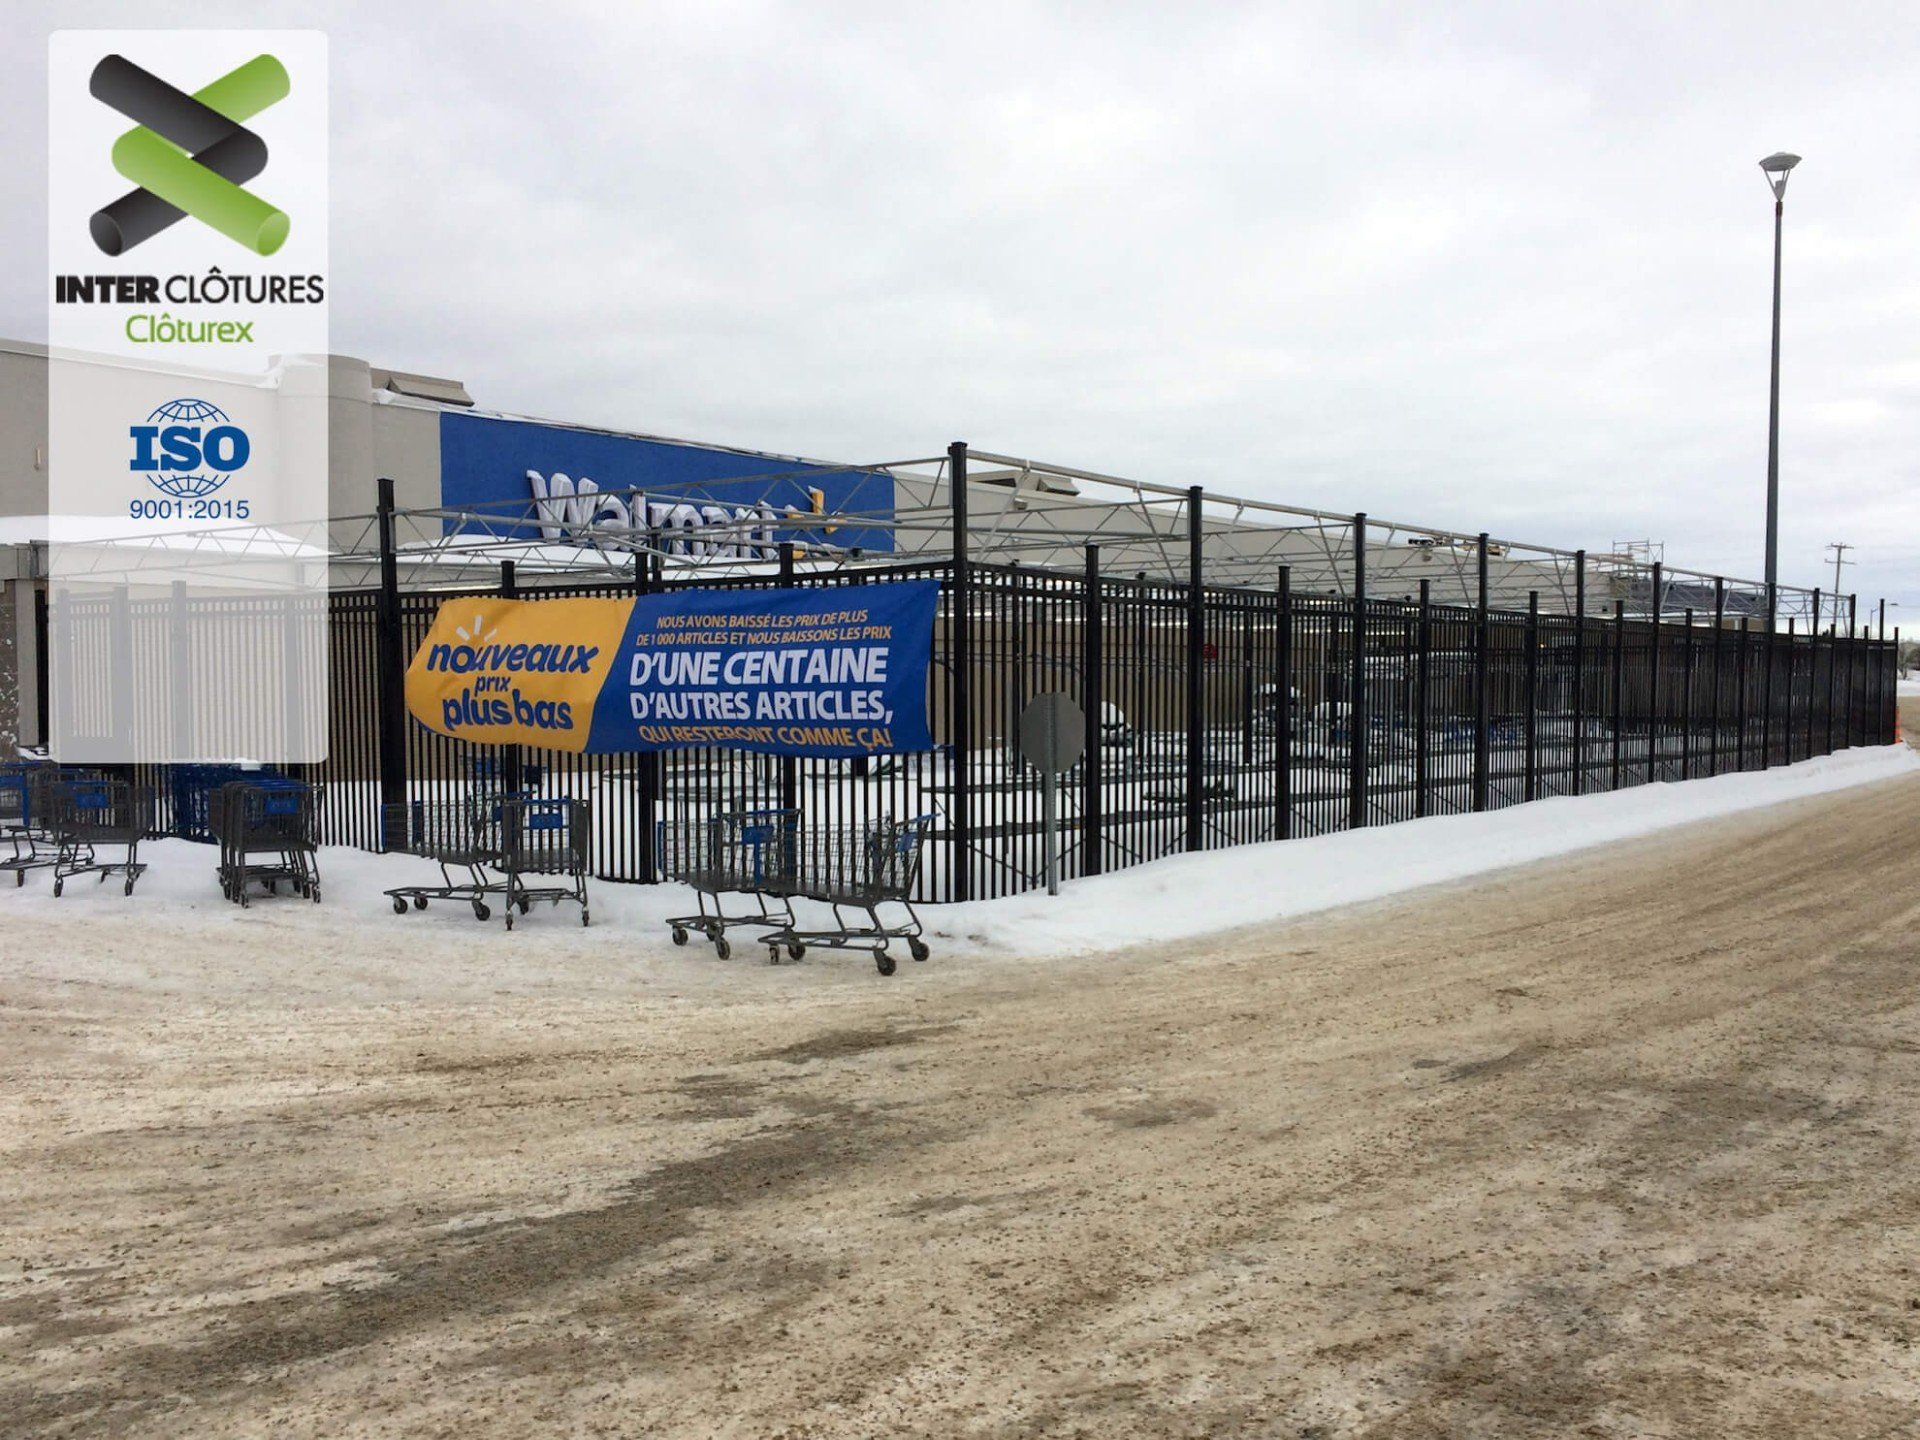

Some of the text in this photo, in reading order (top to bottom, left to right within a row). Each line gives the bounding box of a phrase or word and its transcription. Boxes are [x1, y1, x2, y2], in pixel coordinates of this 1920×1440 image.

[656, 609, 869, 629] NOUS AVONS BAISSÉ LES PRIX DE PLUS
[636, 634, 650, 646] DE
[675, 632, 729, 646] ARTICLES
[729, 632, 747, 645] ET
[747, 630, 781, 645] NOUS
[780, 629, 838, 644] BAISSONS
[838, 627, 862, 641] LES
[861, 625, 893, 640] PRIX
[426, 643, 600, 674] nouveaux
[629, 647, 890, 687] D'UNE CENTAINE
[474, 674, 511, 697] prix
[442, 687, 574, 732] plus bas
[630, 690, 894, 725] D'AUTRES ARTICLES,
[638, 725, 894, 752] QUI RESTERONT COMME ÇA!
